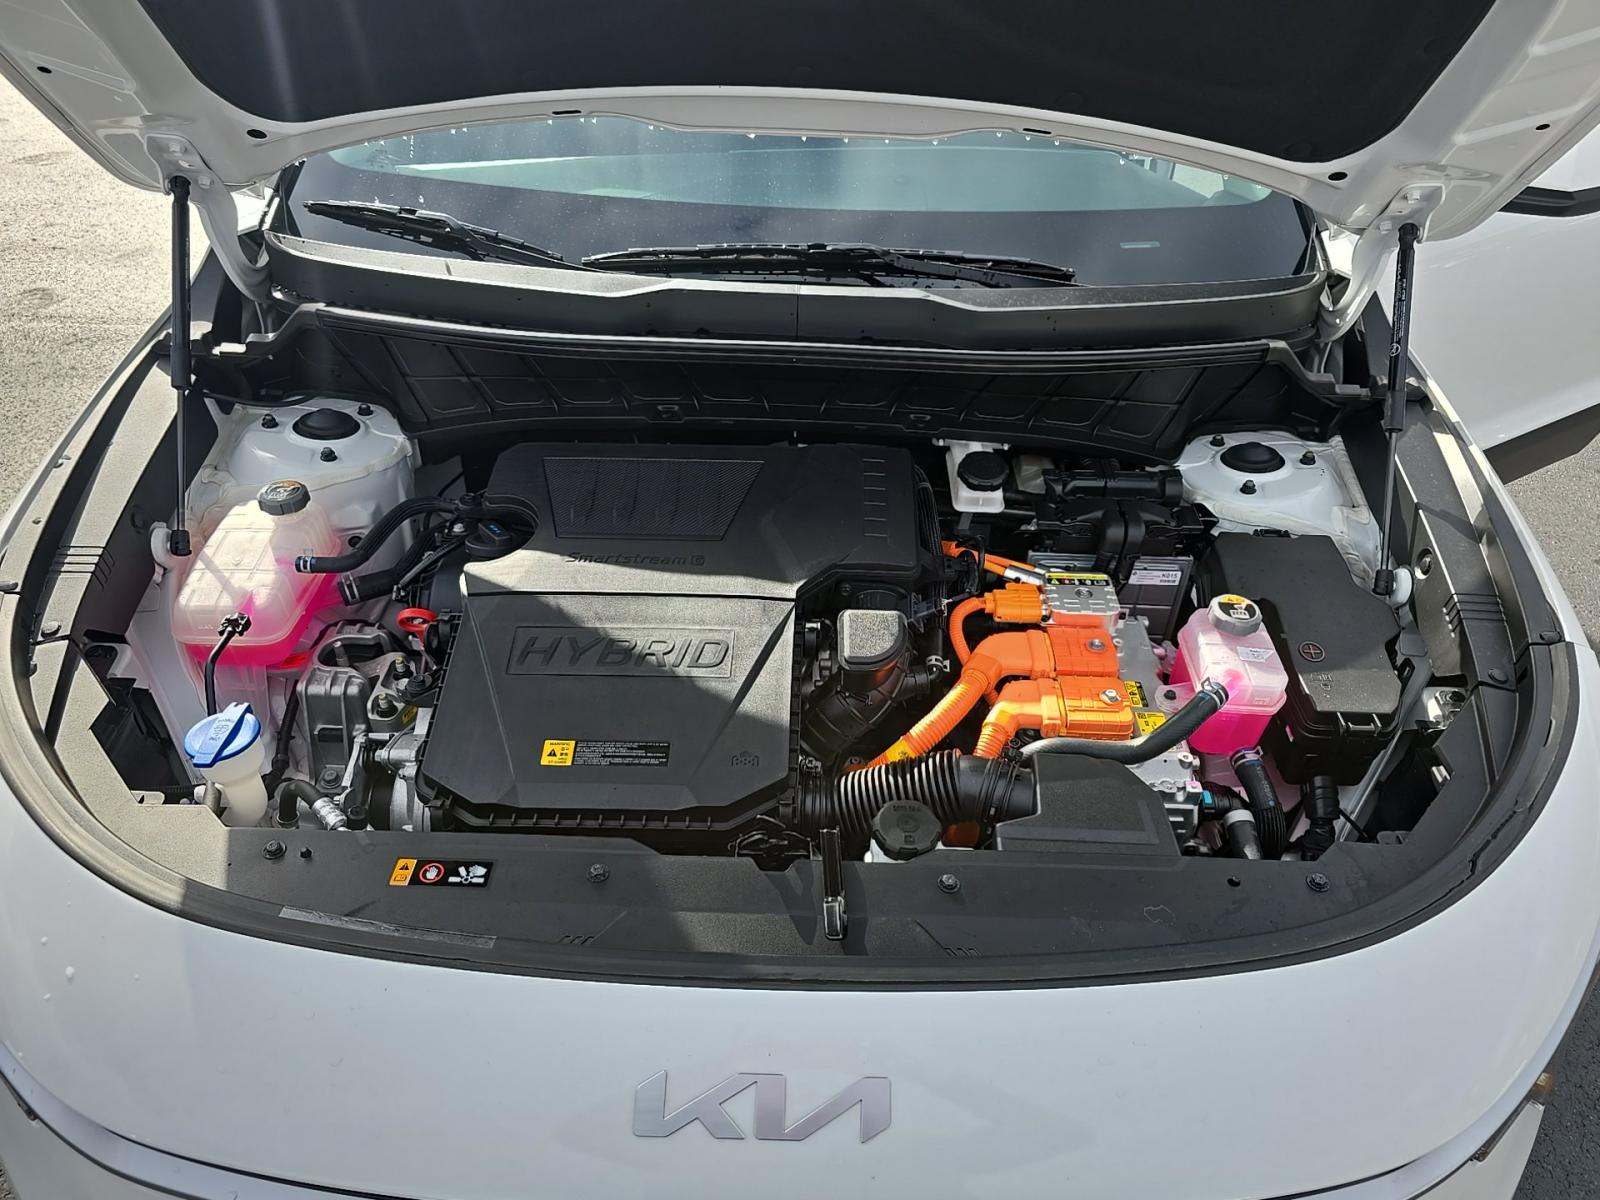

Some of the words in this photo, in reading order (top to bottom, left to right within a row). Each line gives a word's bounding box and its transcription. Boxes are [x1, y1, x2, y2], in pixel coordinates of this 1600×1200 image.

[565, 551, 688, 566] Smartstream
[516, 635, 730, 669] HYBRID
[633, 1070, 892, 1144] KIA
